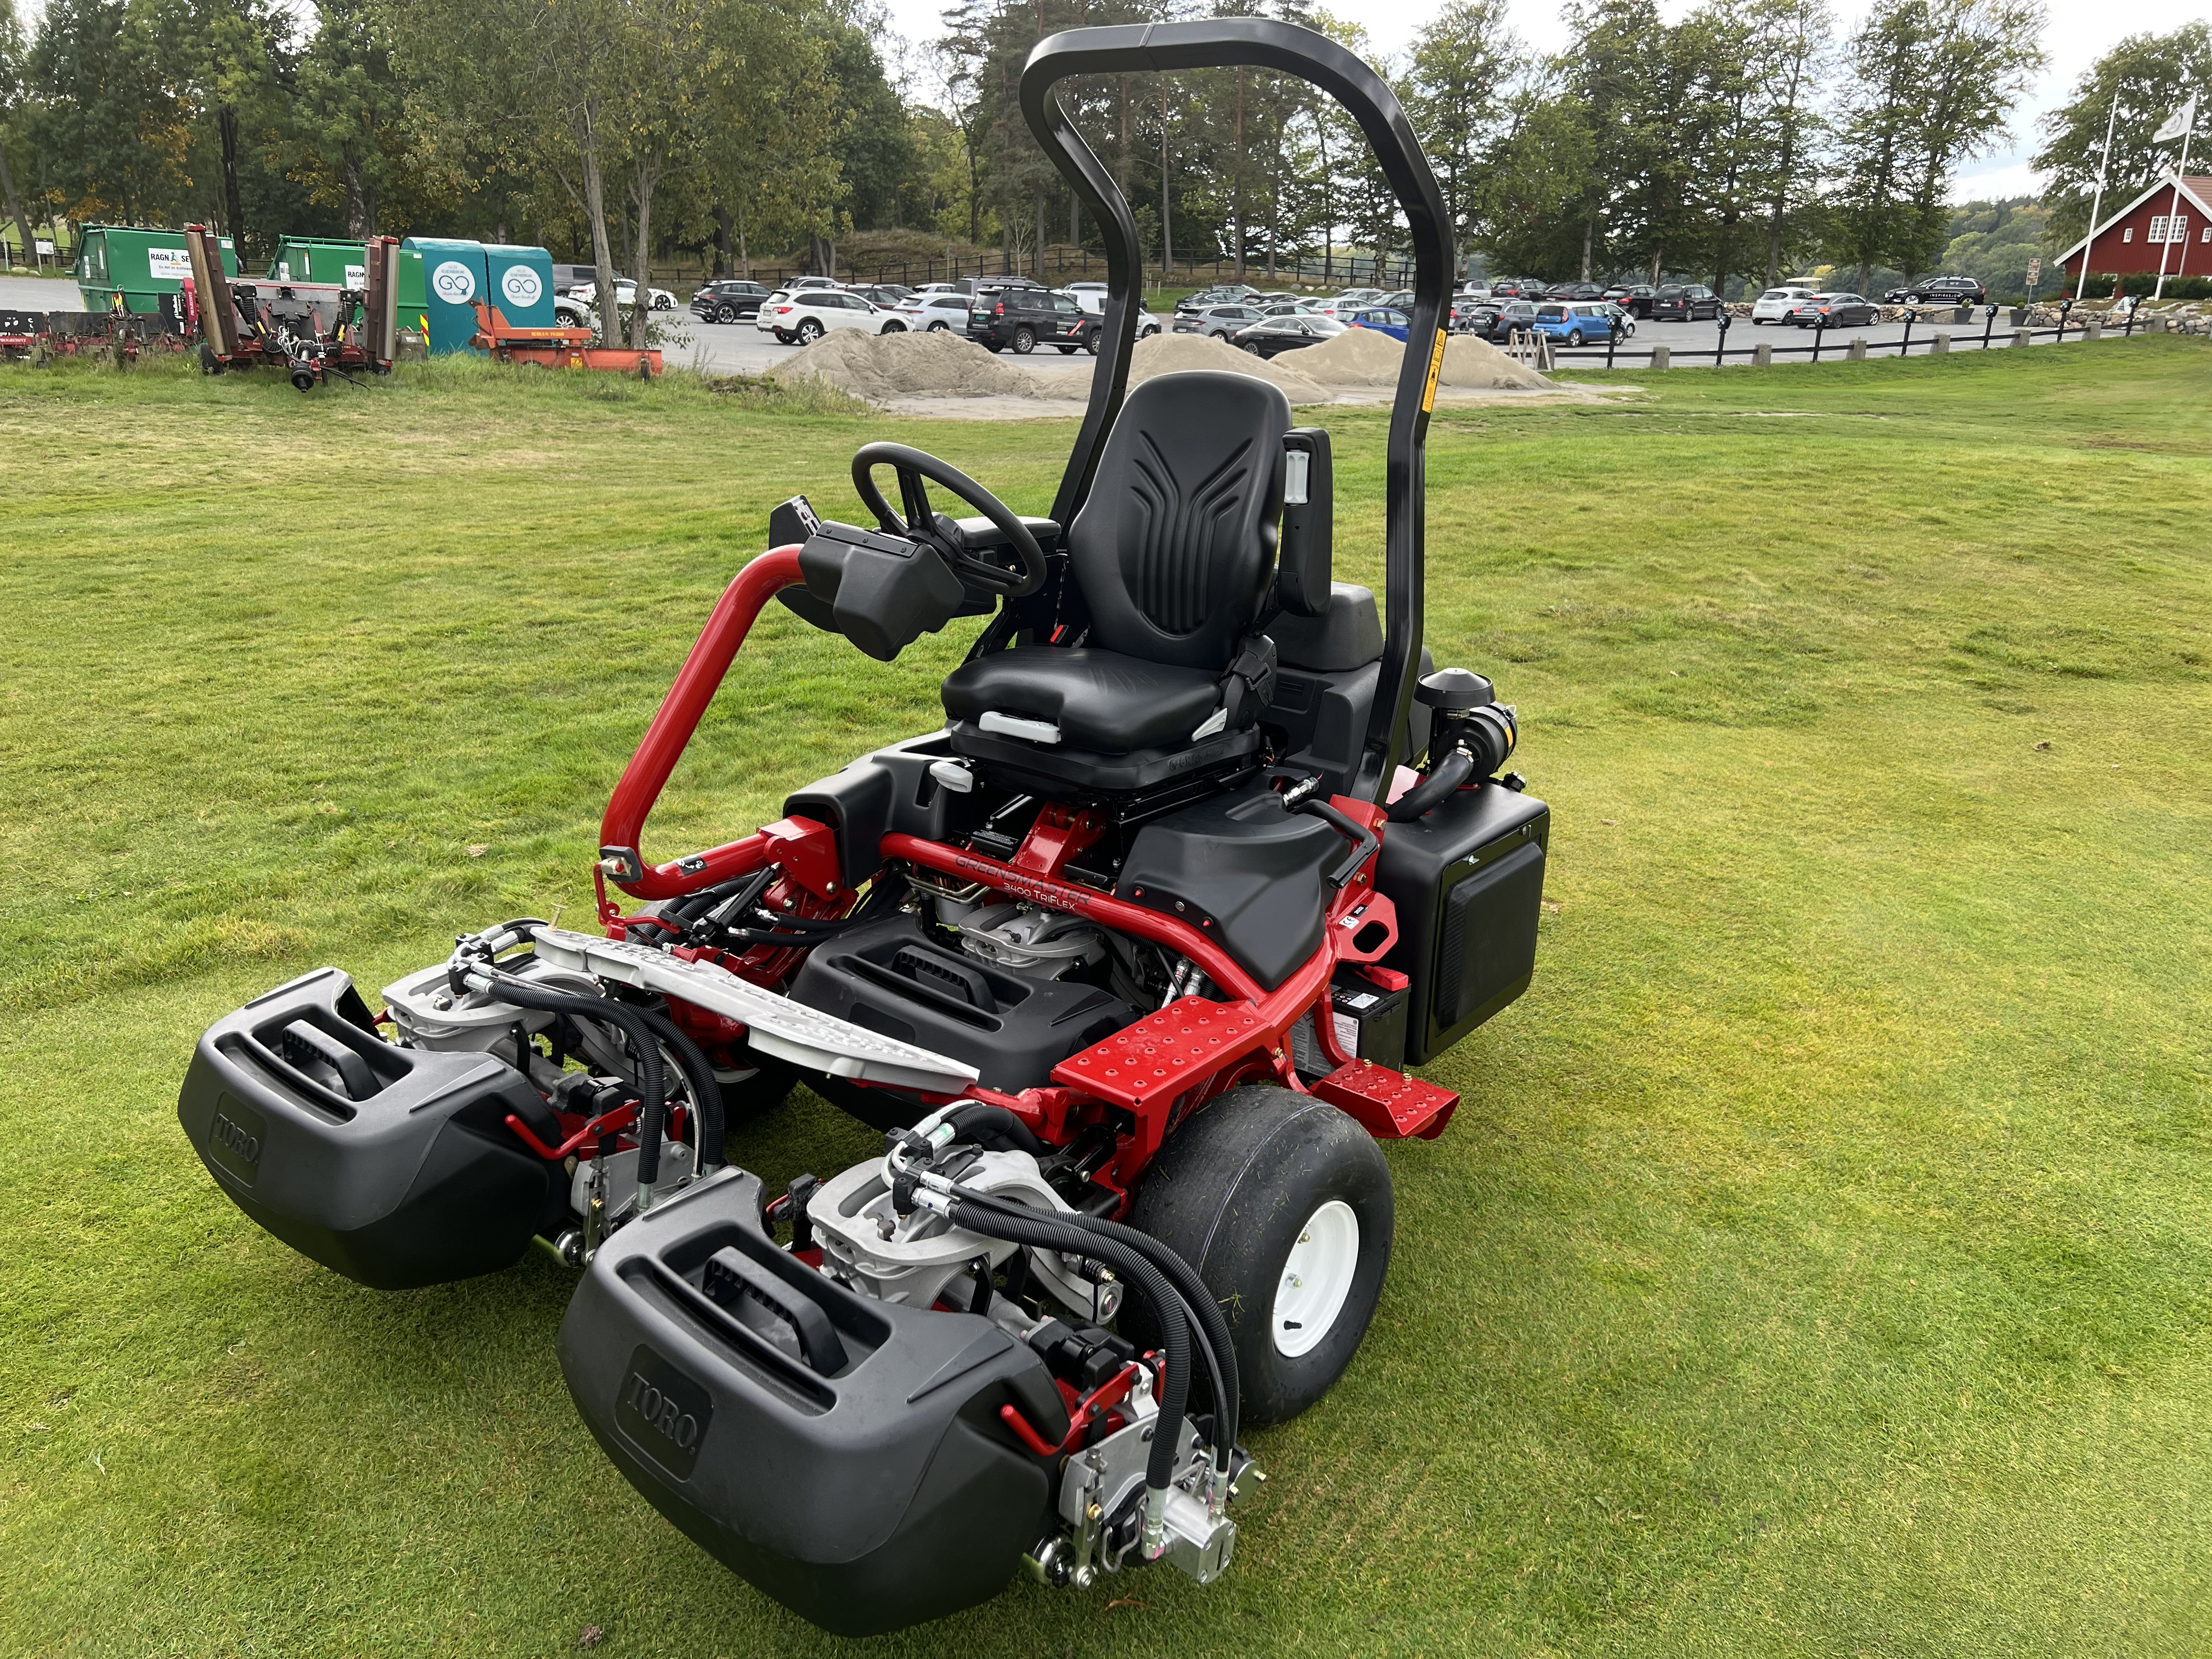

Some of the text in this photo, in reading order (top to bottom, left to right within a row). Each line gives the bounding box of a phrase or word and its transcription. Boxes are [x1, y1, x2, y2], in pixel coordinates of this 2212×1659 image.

[955, 855, 1092, 905] GREENSMASTER
[1003, 882, 1031, 897] 3400
[215, 1113, 259, 1164] TORO
[627, 1372, 698, 1449] TORO
